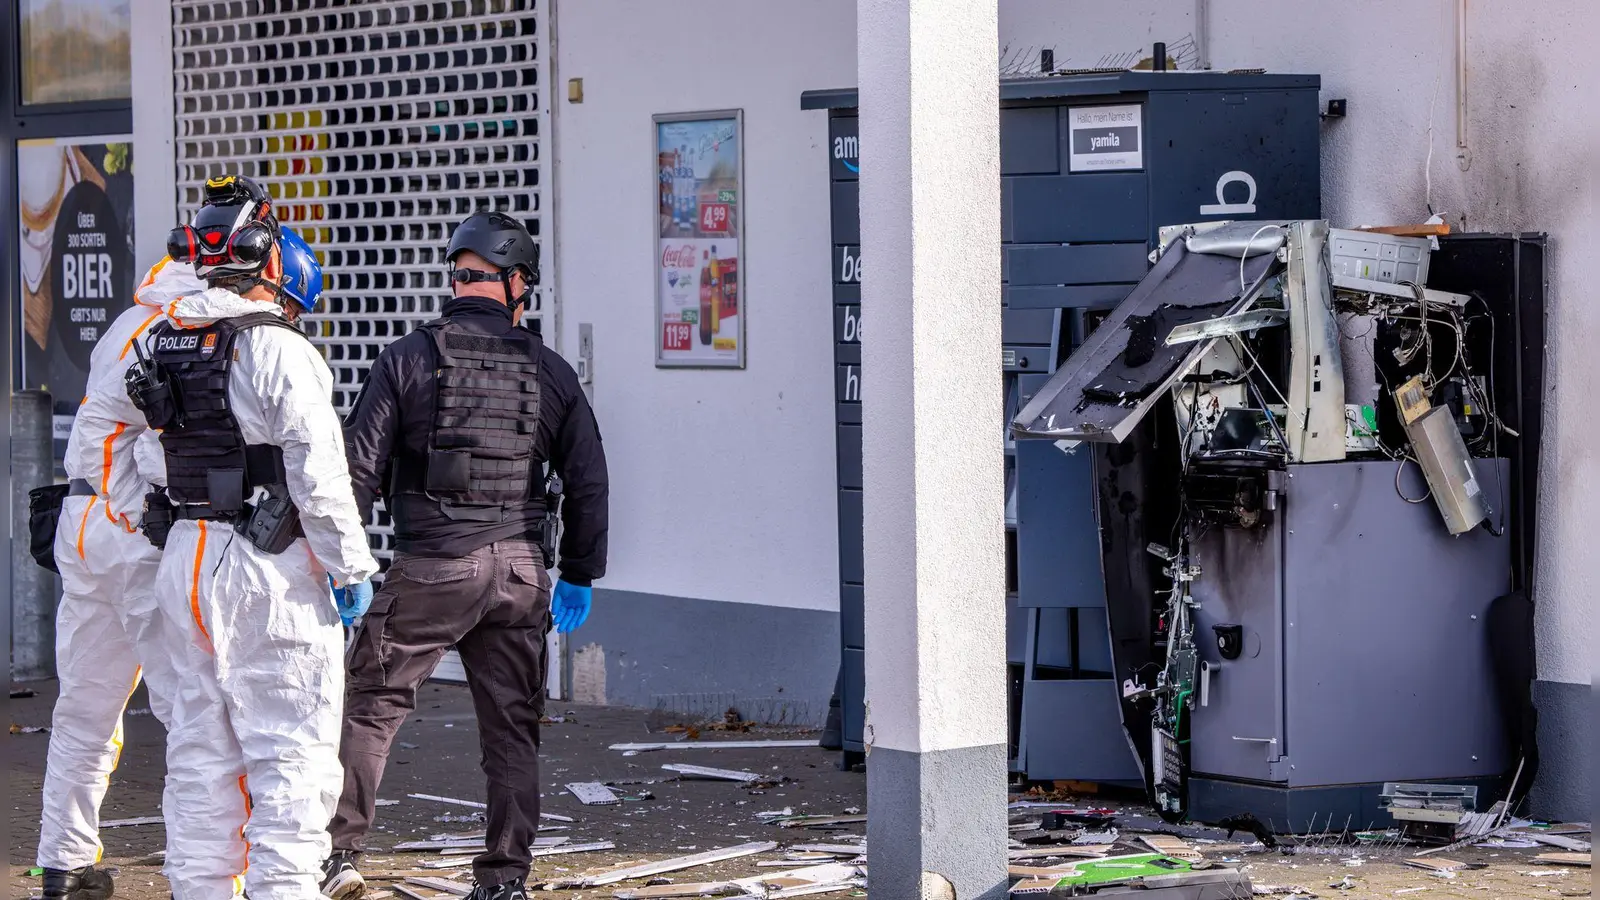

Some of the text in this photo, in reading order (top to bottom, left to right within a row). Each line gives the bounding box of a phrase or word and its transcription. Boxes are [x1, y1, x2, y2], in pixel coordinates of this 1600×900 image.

[1109, 110, 1125, 122] Name
[1090, 132, 1120, 151] yamila
[77, 211, 95, 228] ÜBER
[68, 232, 106, 248] 300 SORTEN
[63, 253, 113, 299] BIER
[91, 307, 106, 322] NUR
[158, 335, 198, 350] POLIZEI
